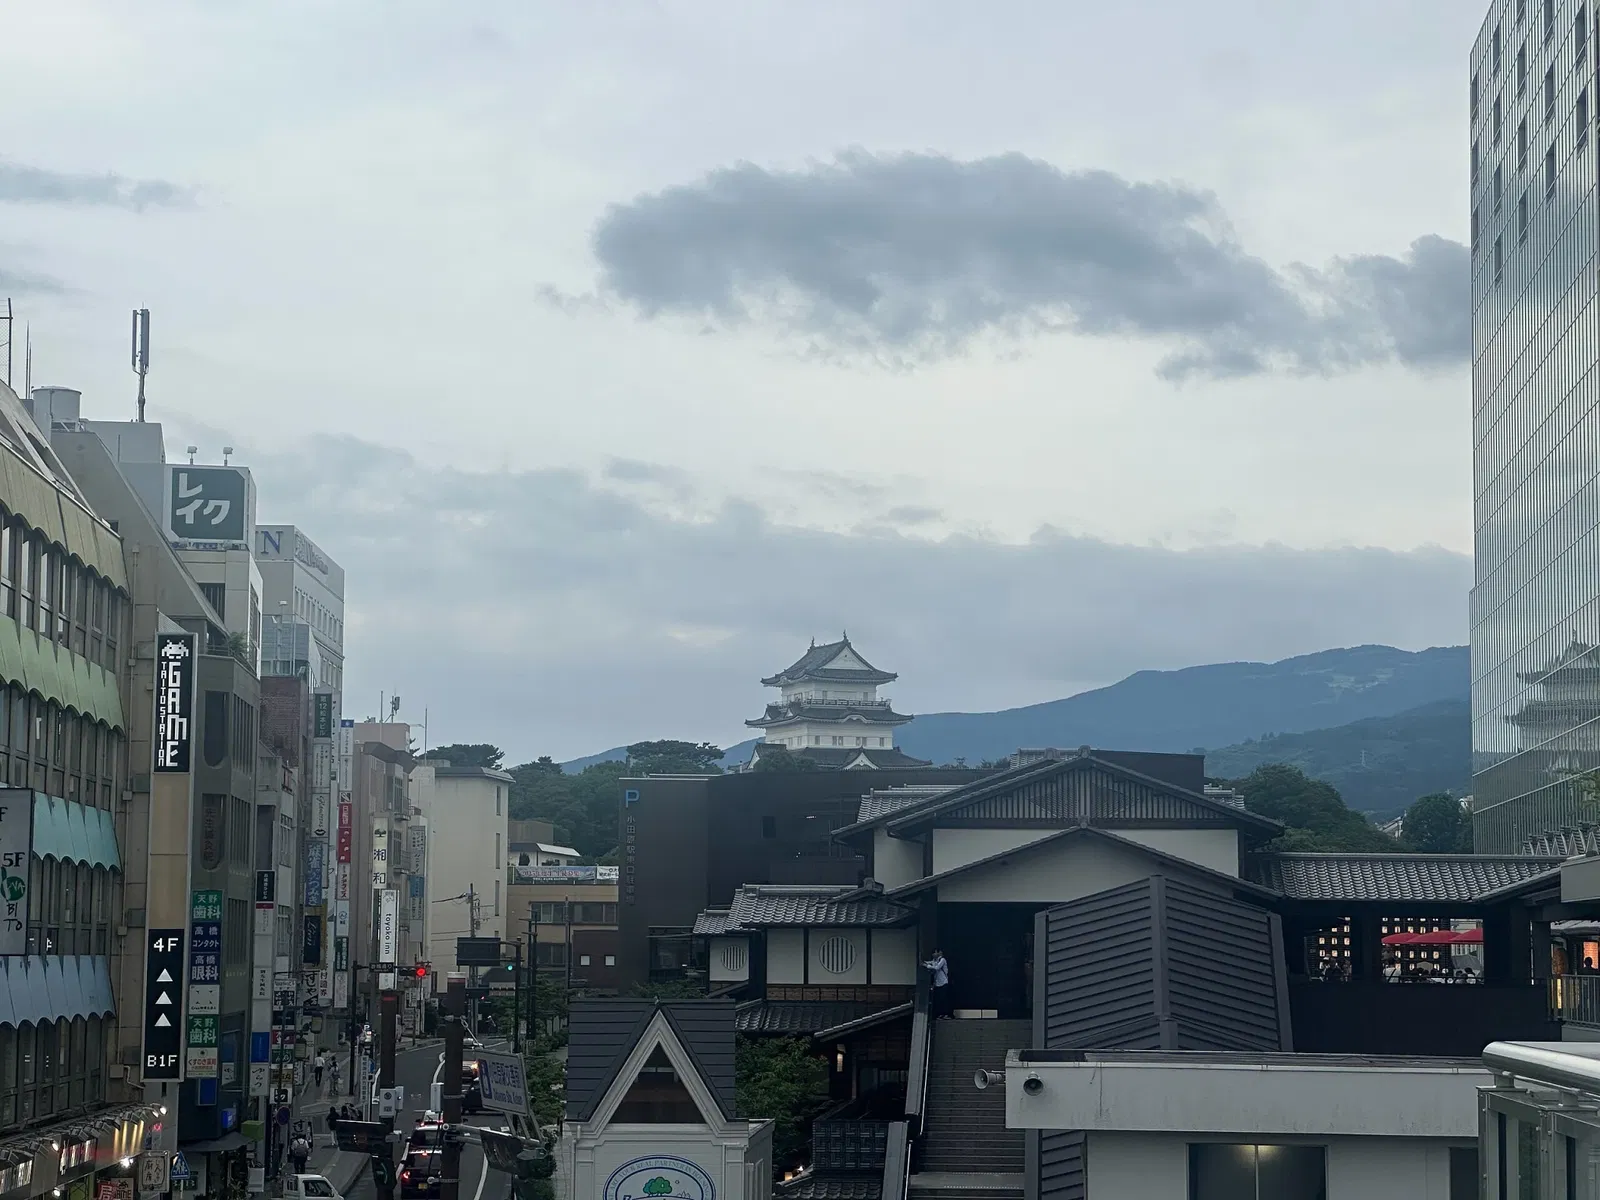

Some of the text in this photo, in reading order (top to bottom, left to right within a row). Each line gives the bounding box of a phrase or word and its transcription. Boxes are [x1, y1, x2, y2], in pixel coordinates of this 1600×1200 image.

[176, 472, 231, 525] レイク
[159, 661, 167, 705] TAITO
[165, 661, 188, 767] GAME
[158, 706, 166, 767] STATION
[625, 789, 640, 809] P
[2, 852, 25, 867] 5F
[373, 849, 387, 885] 湘和
[197, 894, 218, 904] 天野
[193, 904, 221, 919] 歯科
[194, 926, 218, 936] 高橋
[384, 913, 392, 940] toyoko
[153, 937, 179, 952] 4F
[192, 939, 219, 948] コンタクト
[195, 955, 216, 965] 高橋
[191, 965, 219, 981] 眼科
[193, 1018, 214, 1028] 天野
[189, 1028, 217, 1044] 歯科
[147, 1054, 178, 1068] B1F
[654, 1160, 684, 1169] PARTNER
